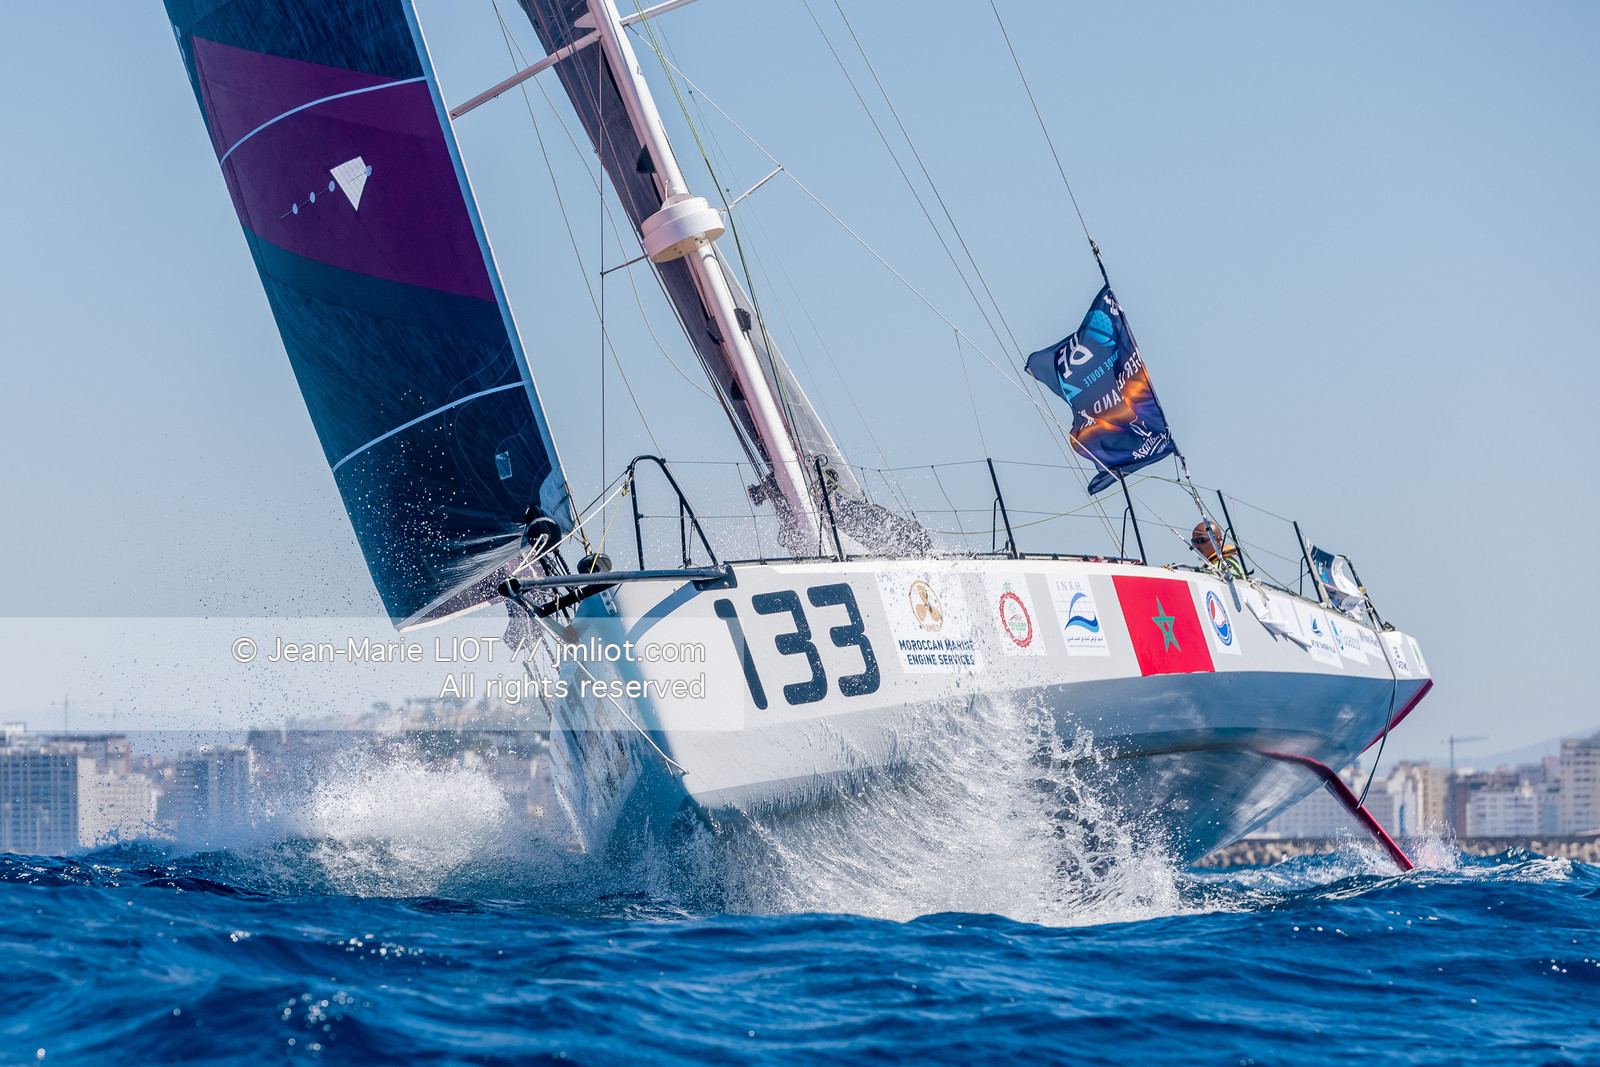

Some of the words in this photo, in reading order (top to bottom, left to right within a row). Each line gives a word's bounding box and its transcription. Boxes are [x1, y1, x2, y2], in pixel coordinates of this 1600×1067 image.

[1055, 581, 1082, 591] INRH
[713, 582, 881, 710] 133
[898, 639, 944, 651] MOROCCAN
[944, 639, 975, 651] MARINE
[938, 654, 976, 665] SERVICES
